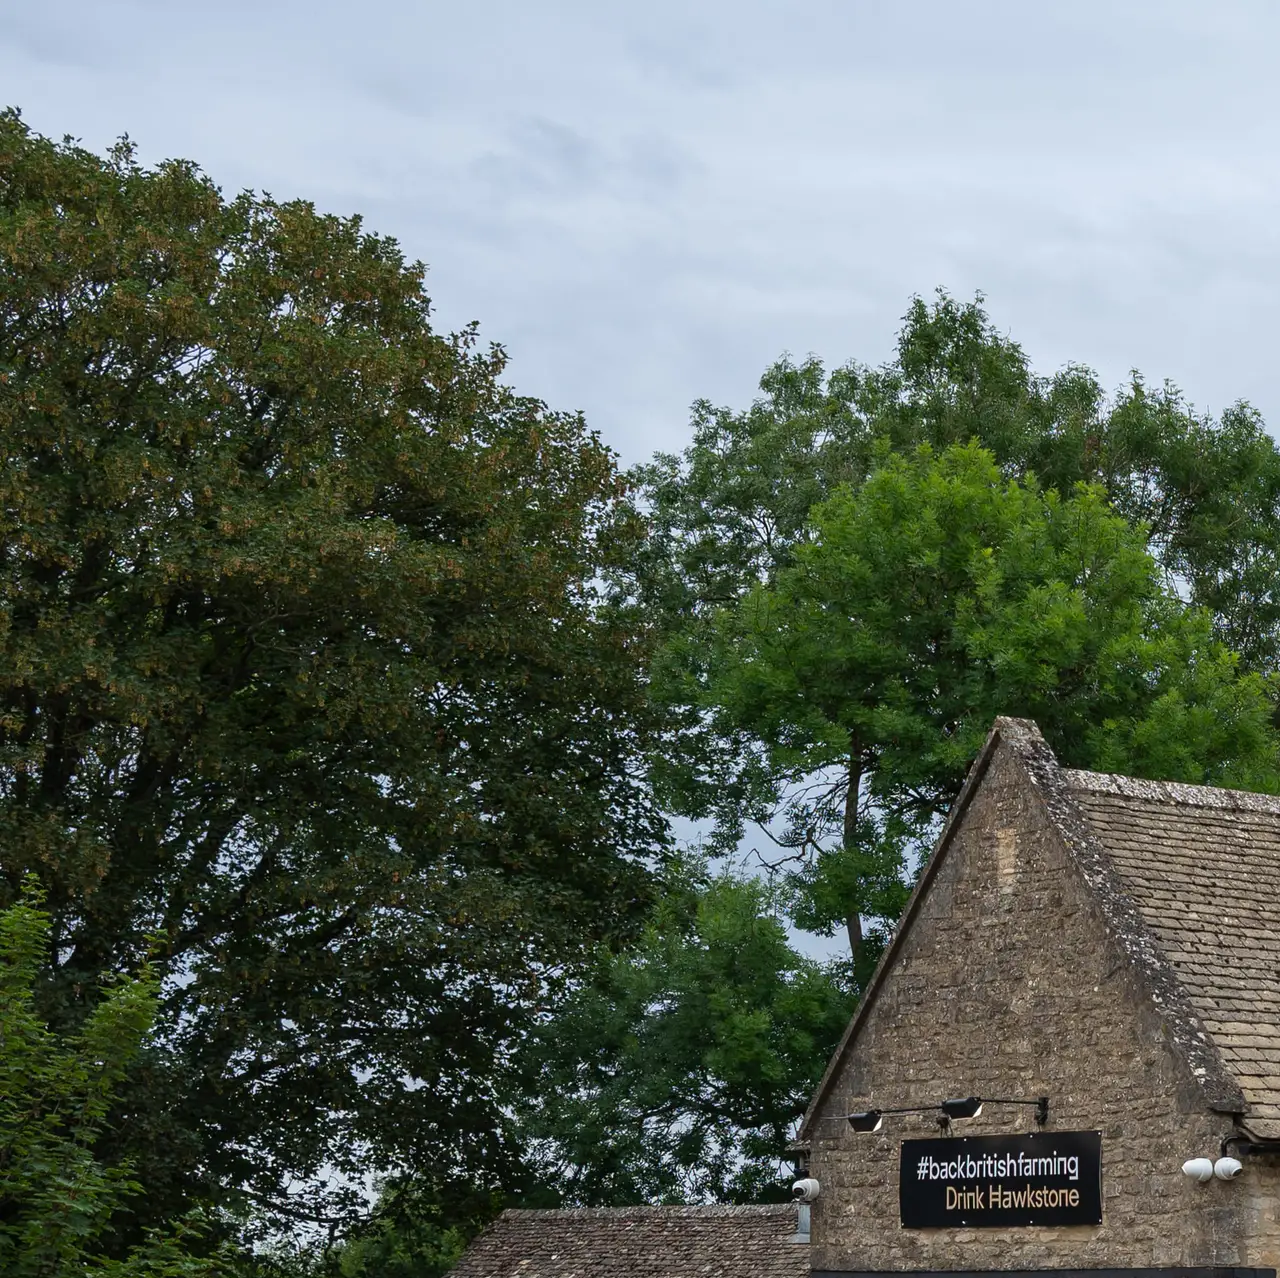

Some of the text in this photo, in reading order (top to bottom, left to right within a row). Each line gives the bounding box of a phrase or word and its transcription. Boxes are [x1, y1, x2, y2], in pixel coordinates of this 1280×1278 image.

[917, 1151, 1079, 1181] #backbritishfarming
[946, 1184, 1080, 1210] Drink Hawkstone
